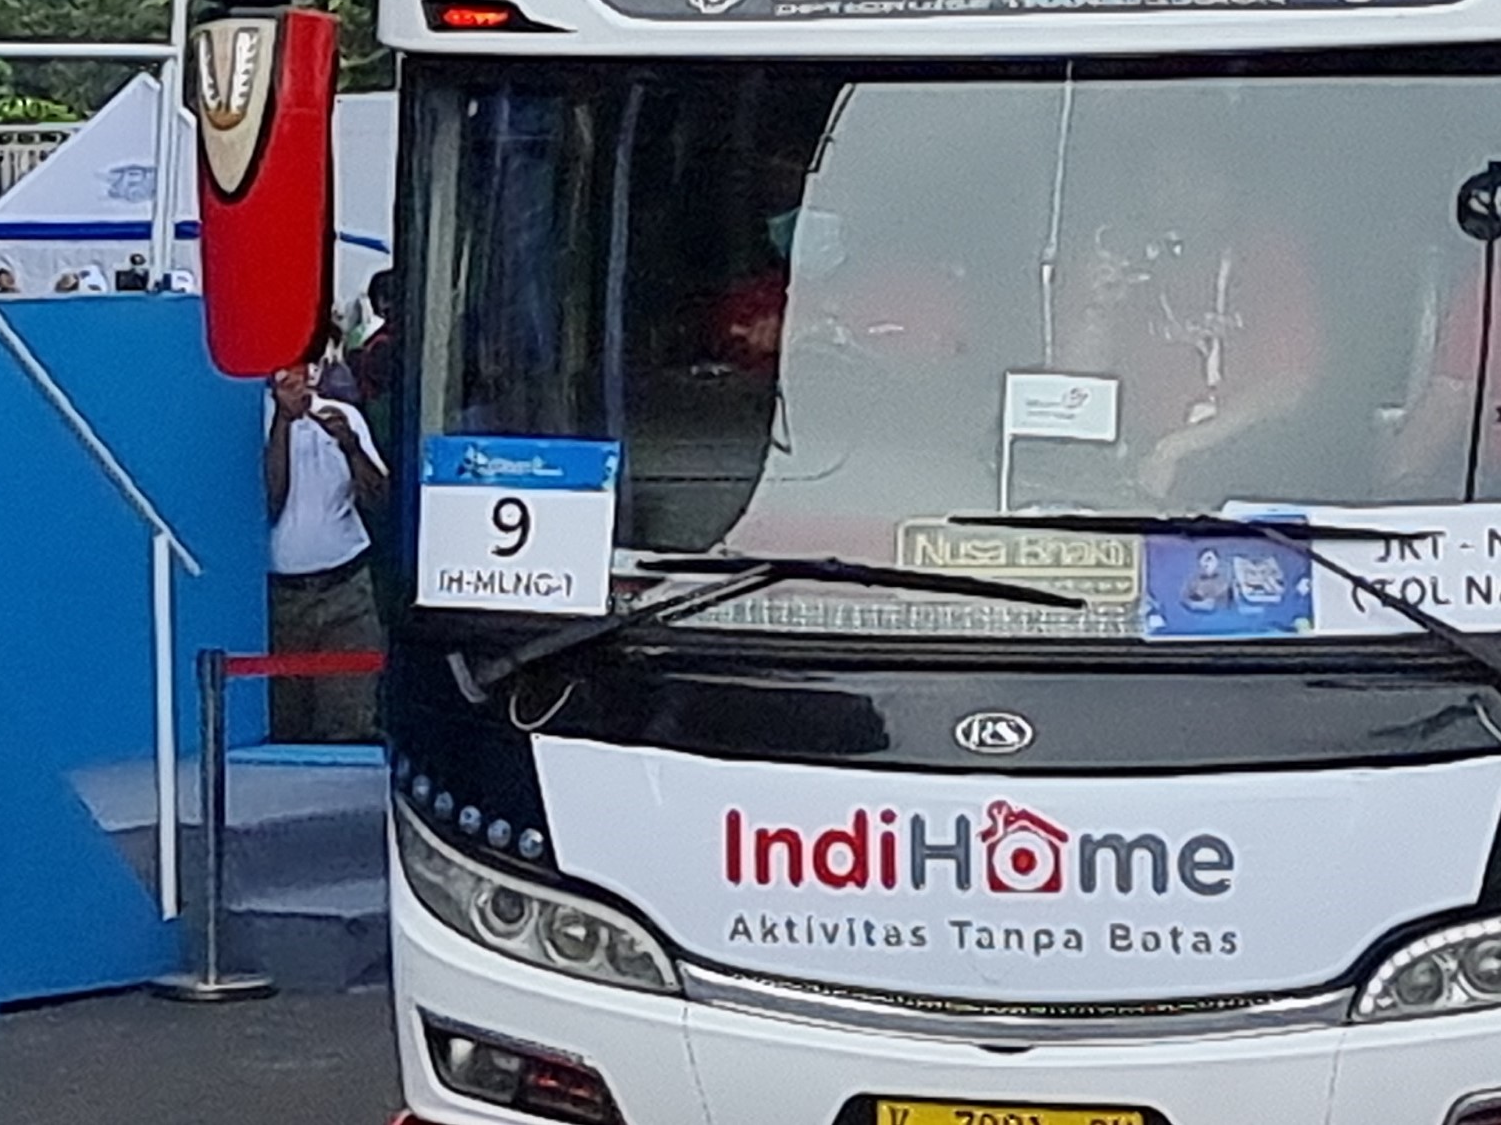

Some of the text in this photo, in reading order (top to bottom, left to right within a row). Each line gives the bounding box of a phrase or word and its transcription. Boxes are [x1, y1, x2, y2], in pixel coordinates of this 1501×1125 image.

[490, 496, 531, 558] 9
[724, 800, 1235, 896] IndiHome
[728, 914, 928, 949] Aktivitas
[948, 919, 1085, 957] Tanpa
